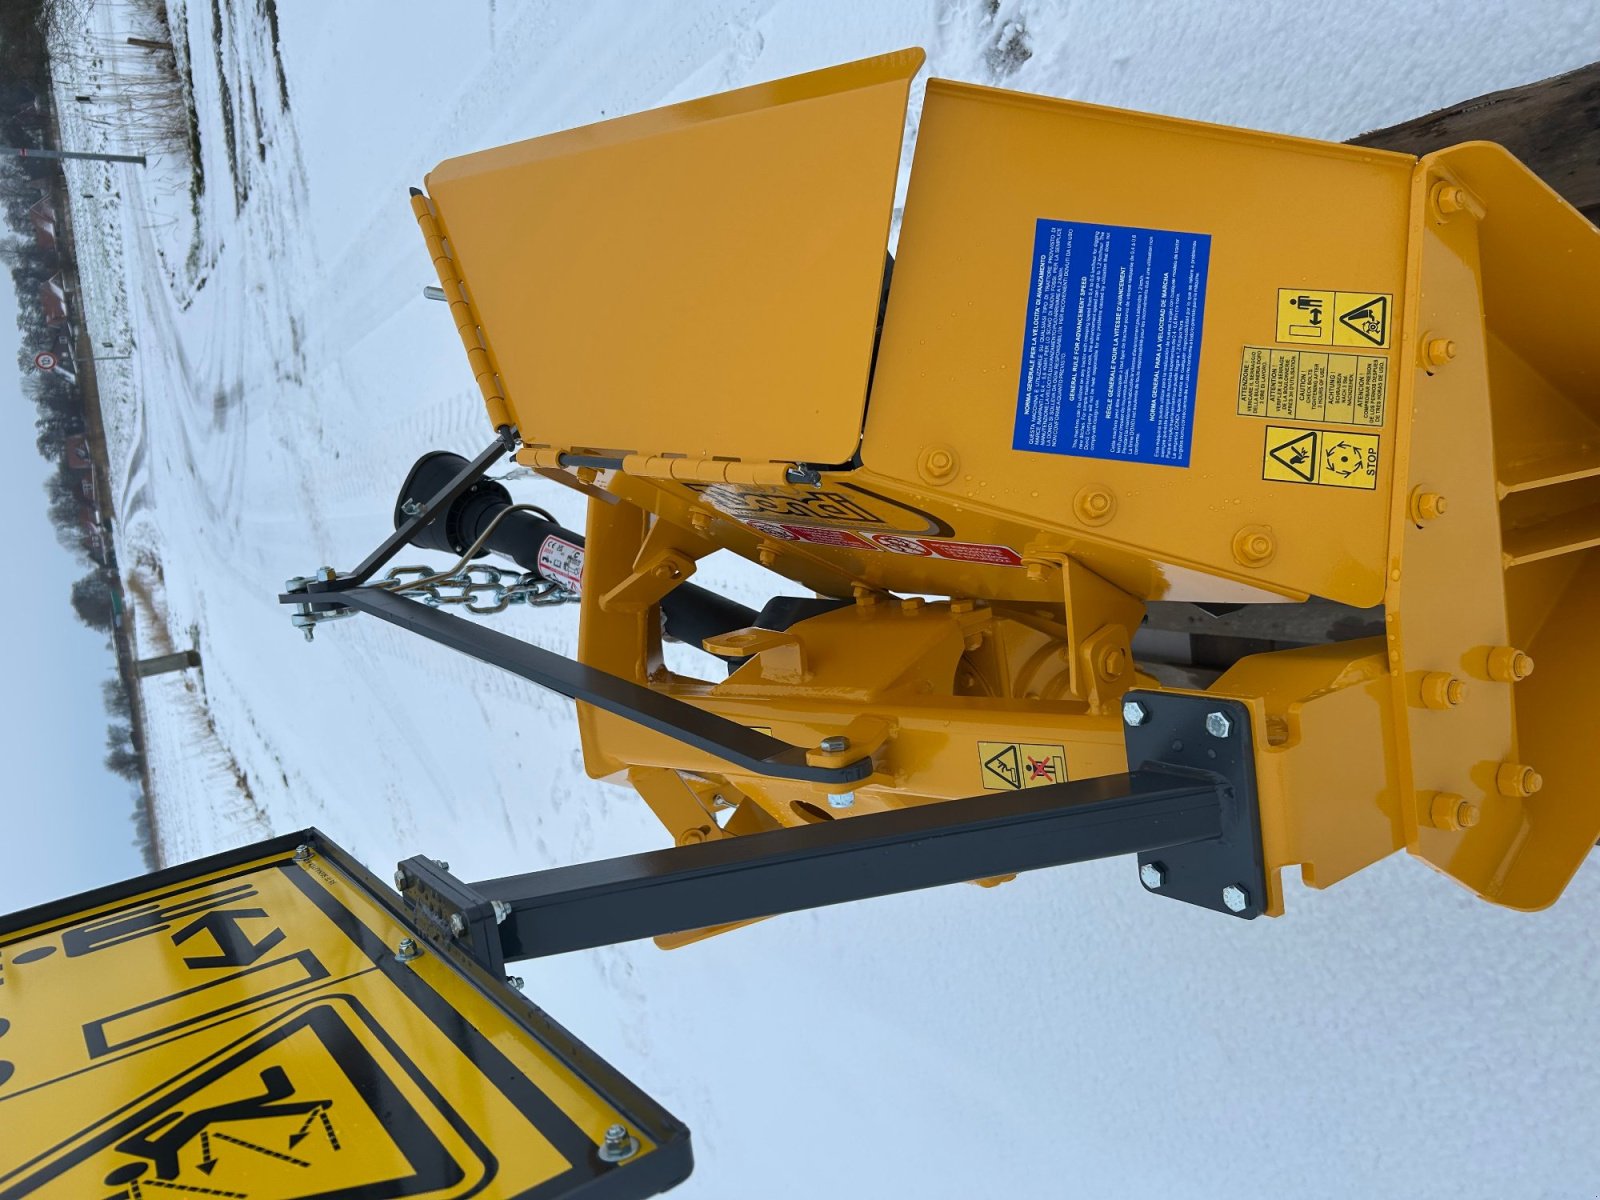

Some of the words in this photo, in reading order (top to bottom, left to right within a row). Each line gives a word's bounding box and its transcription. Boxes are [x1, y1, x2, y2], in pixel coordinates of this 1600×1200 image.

[1036, 254, 1047, 298] AVANZAMENTO
[1161, 272, 1170, 298] MARCHA
[1160, 299, 1167, 308] DE
[1113, 312, 1122, 337] VITESSE
[1157, 308, 1166, 343] VELOCIDAD
[1031, 337, 1038, 345] LA
[1069, 372, 1077, 402] GENERAL
[1075, 297, 1085, 342] ADVANCEMENT
[1112, 337, 1119, 347] LA
[1156, 343, 1163, 352] LA
[1110, 346, 1118, 364] POUR
[1154, 352, 1162, 369] PARA
[1026, 359, 1036, 392] GENERALE
[1151, 370, 1160, 398] GENERAL
[1240, 364, 1250, 401] ATTENZIONE
[1269, 368, 1278, 402] ATTENTION
[1328, 374, 1336, 404] ACHTUNG
[1024, 392, 1032, 415] NORMA
[1357, 376, 1365, 407] ATENCION
[1149, 399, 1157, 422] NORMA
[1366, 447, 1377, 477] STOP
